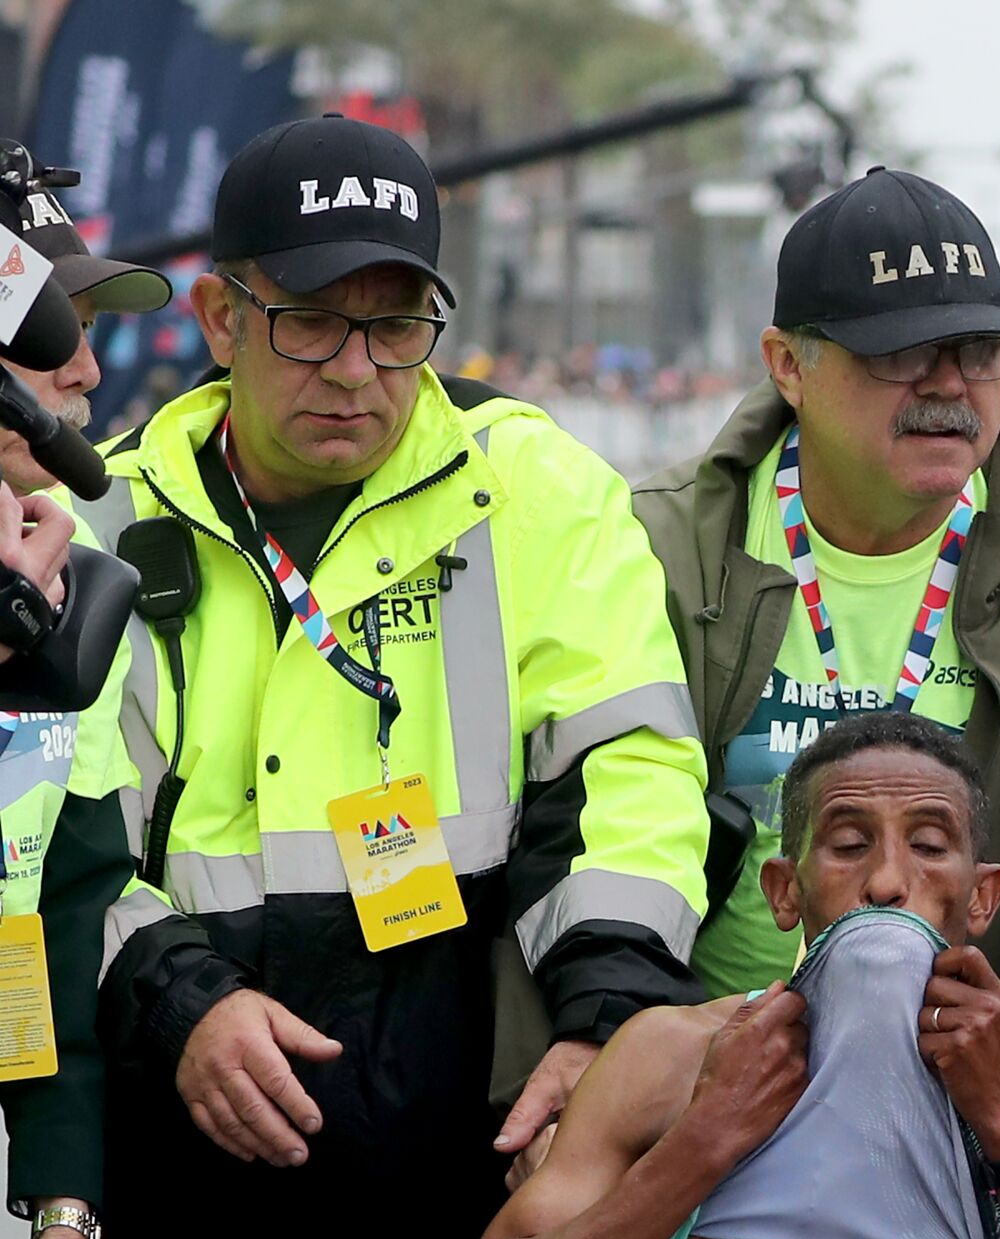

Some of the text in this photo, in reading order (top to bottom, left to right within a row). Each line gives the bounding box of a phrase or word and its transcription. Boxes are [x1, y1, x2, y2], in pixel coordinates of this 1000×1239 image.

[299, 176, 419, 222] LAFD
[869, 241, 986, 285] LAFD
[11, 598, 41, 636] Canon
[379, 630, 437, 646] EPARTMEN
[403, 777, 422, 789] 2023
[366, 831, 414, 850] LOS ANGELES
[367, 837, 416, 857] MARATHON
[383, 901, 442, 926] FINISH LINE
